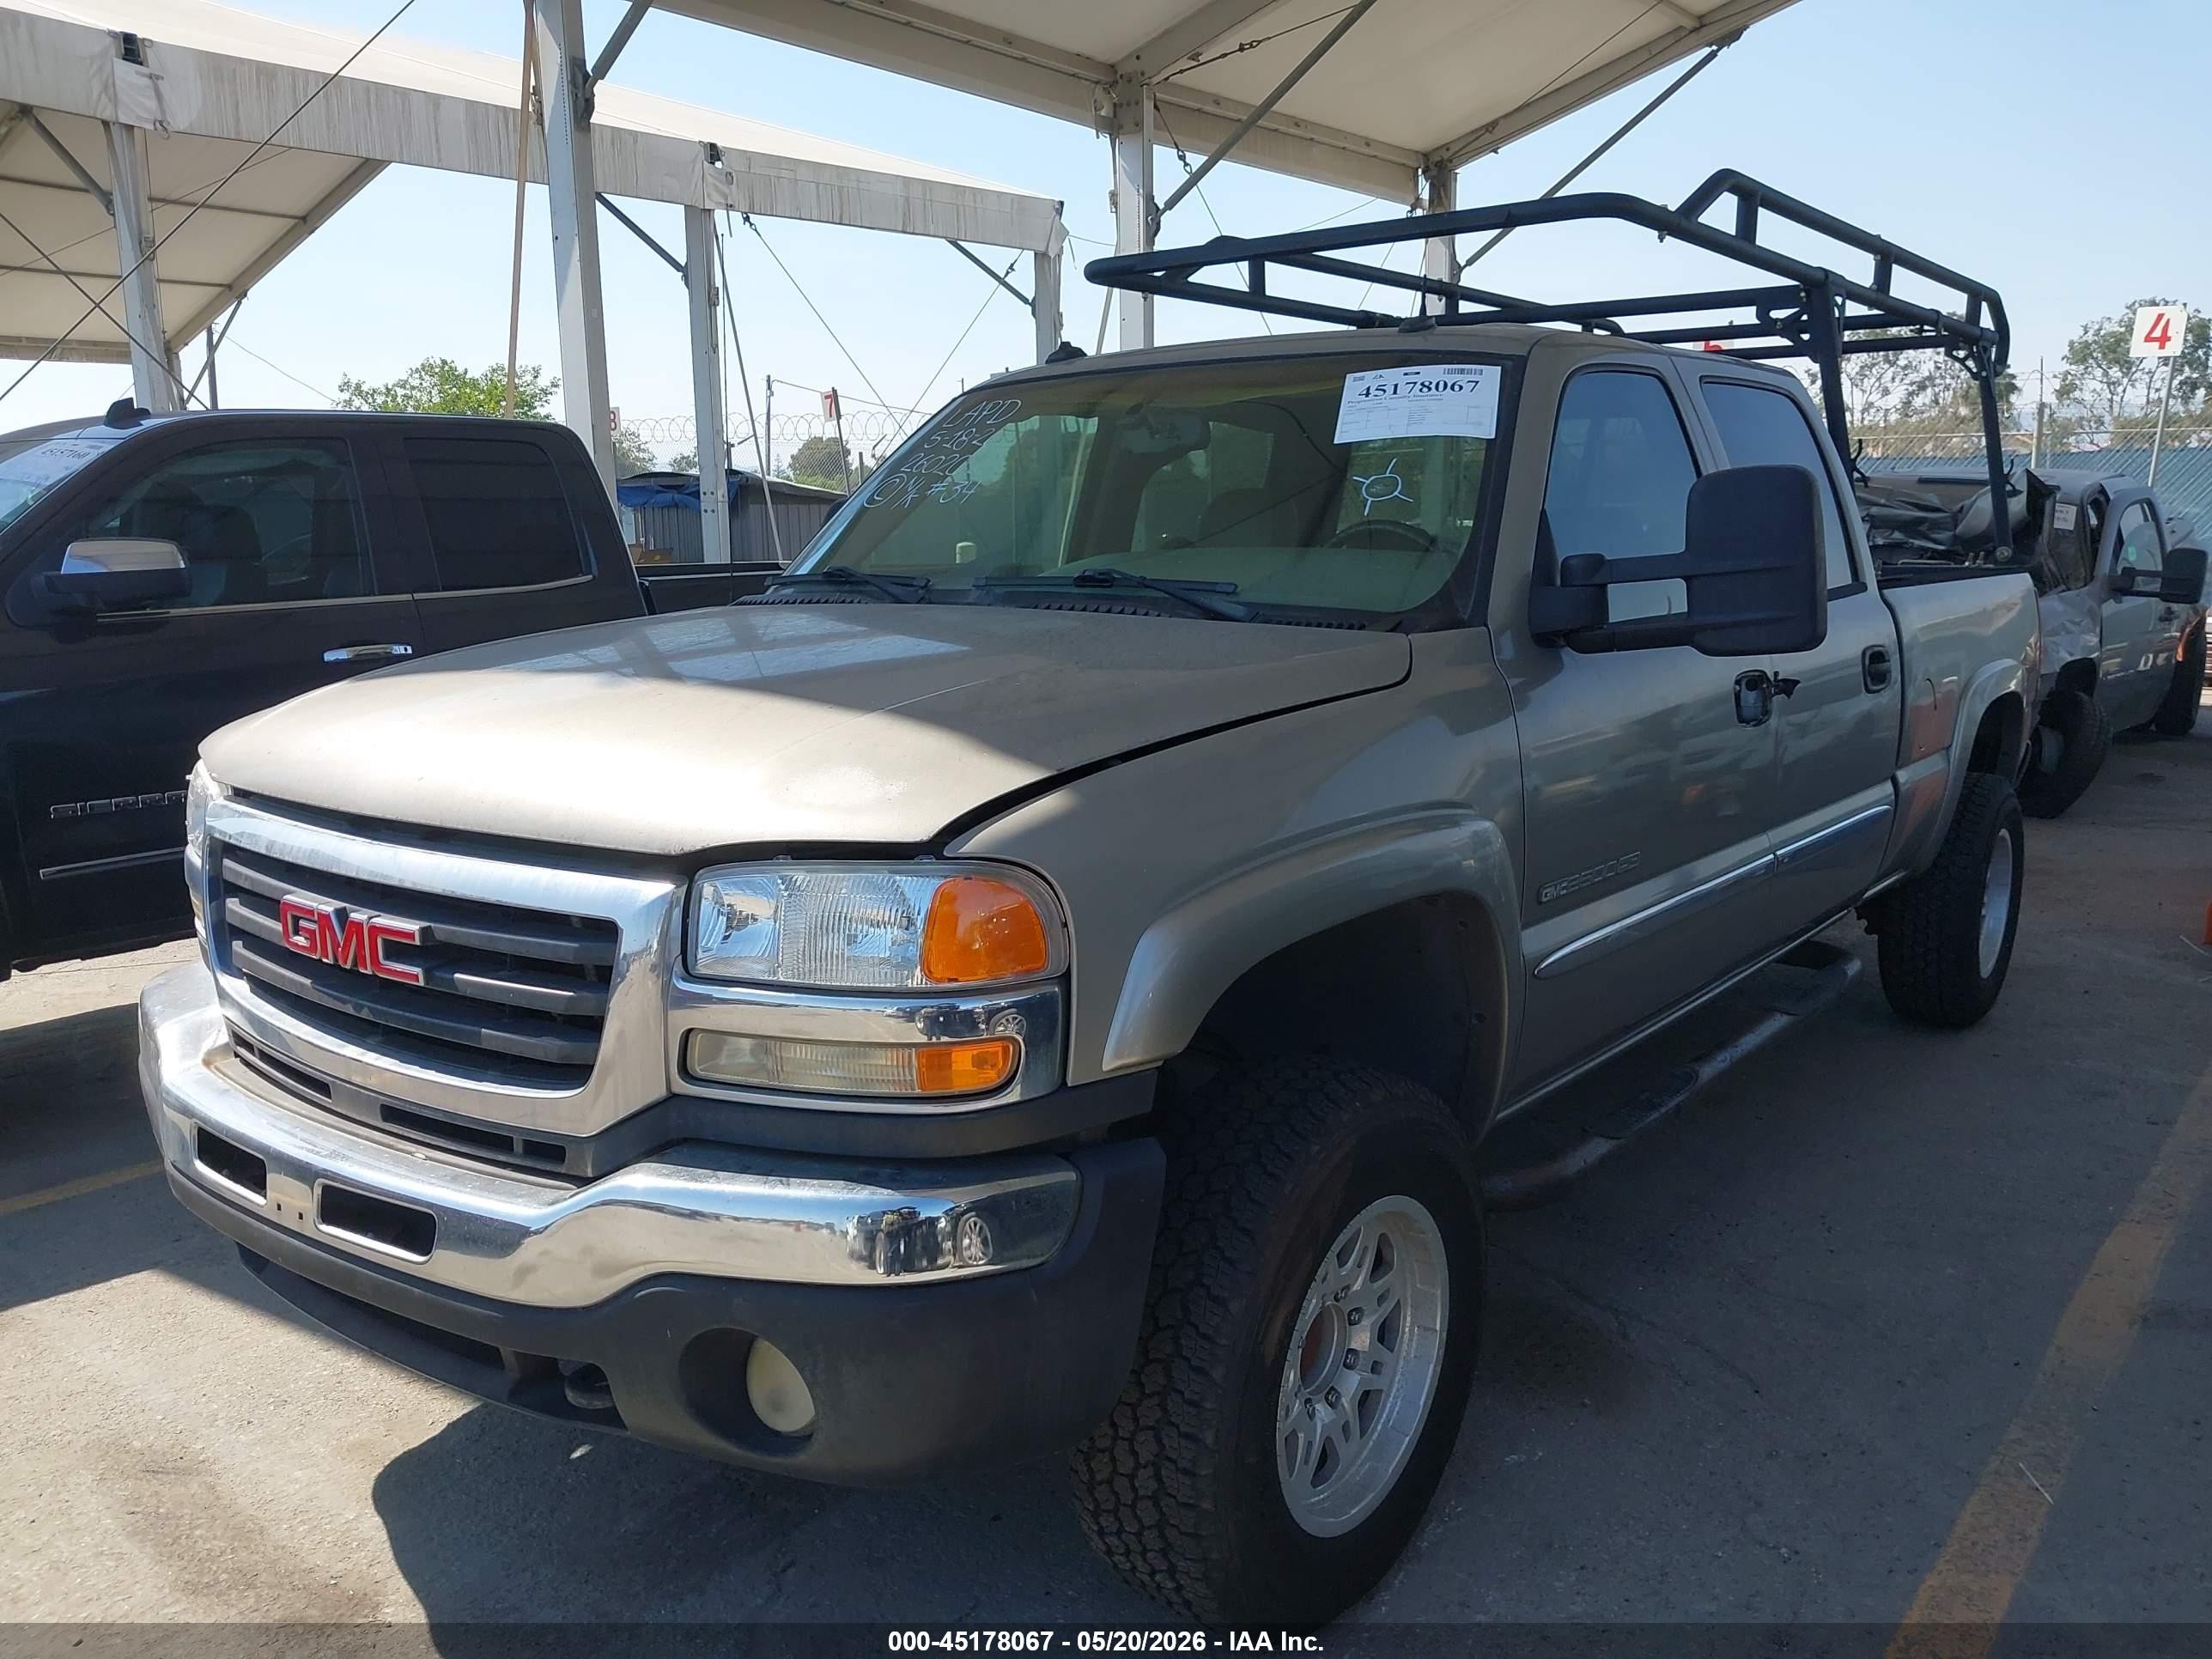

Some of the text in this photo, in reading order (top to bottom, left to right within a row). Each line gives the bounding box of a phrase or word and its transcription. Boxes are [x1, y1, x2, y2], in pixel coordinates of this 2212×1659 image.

[2143, 313, 2172, 349] 4
[1358, 380, 1480, 398] 45178067
[823, 393, 835, 418] 7
[942, 398, 1023, 428] LAPD
[50, 790, 188, 819] SIERRA
[279, 892, 426, 988] GMC
